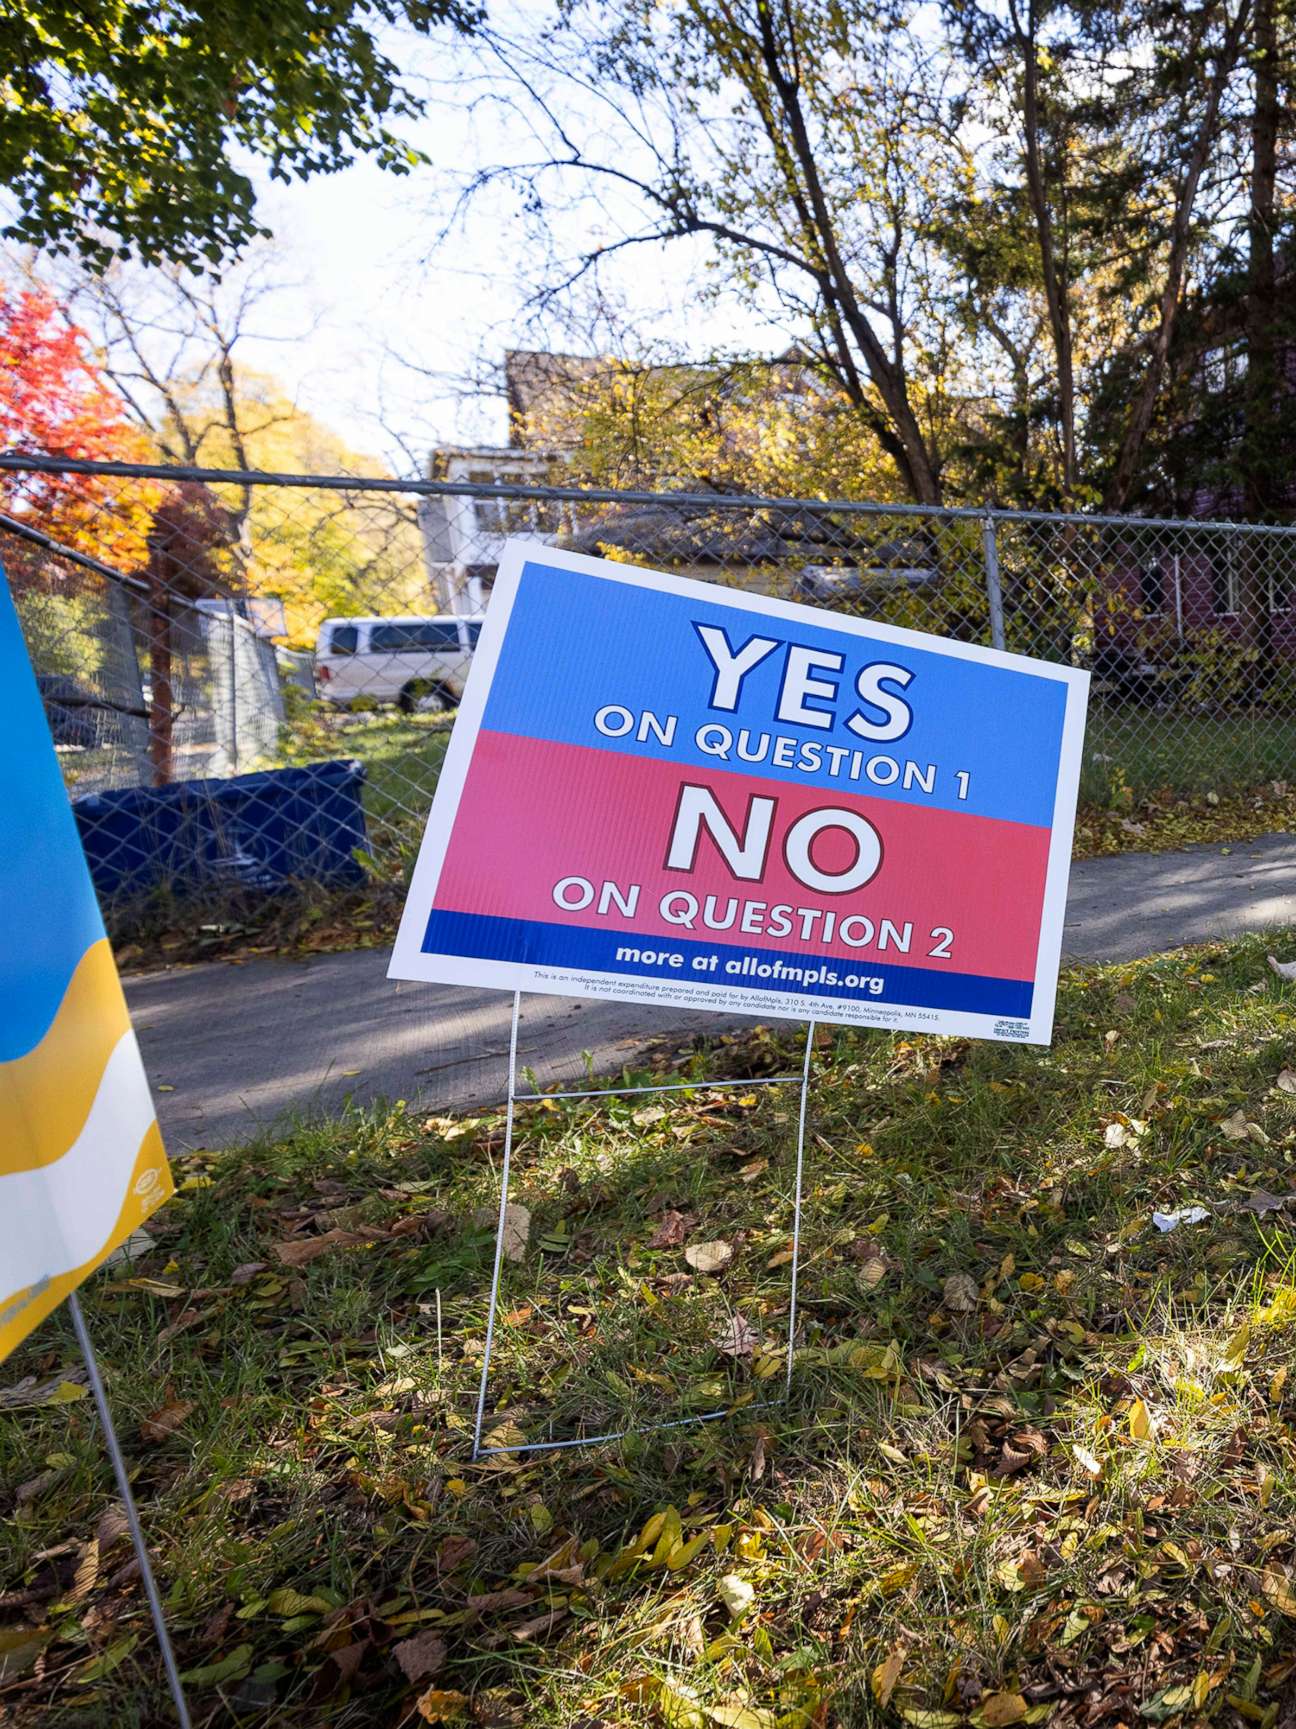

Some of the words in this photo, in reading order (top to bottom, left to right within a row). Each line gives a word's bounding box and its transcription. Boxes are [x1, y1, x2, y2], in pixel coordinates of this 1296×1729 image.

[690, 621, 917, 744] YES
[594, 704, 678, 747] ON
[694, 723, 937, 794] QUESTION
[954, 769, 971, 801] 1
[663, 781, 884, 896] NO
[552, 875, 641, 919] ON
[659, 889, 913, 954] QUESTION
[928, 926, 955, 959] 2
[534, 971, 548, 979] This
[571, 975, 616, 985] independent
[618, 982, 659, 990] expenditure
[662, 985, 694, 995] prepared
[696, 988, 709, 996] and
[711, 990, 727, 998] paid
[741, 993, 749, 1001] by
[612, 987, 655, 997] coordinated
[657, 991, 672, 999] with
[684, 995, 716, 1004] approved
[719, 997, 727, 1005] by
[728, 1000, 740, 1008] any
[743, 1001, 775, 1010] candidate
[812, 1009, 843, 1017] candidate
[616, 946, 684, 969] more
[692, 951, 718, 972] at
[725, 957, 885, 994] allofmpls.org
